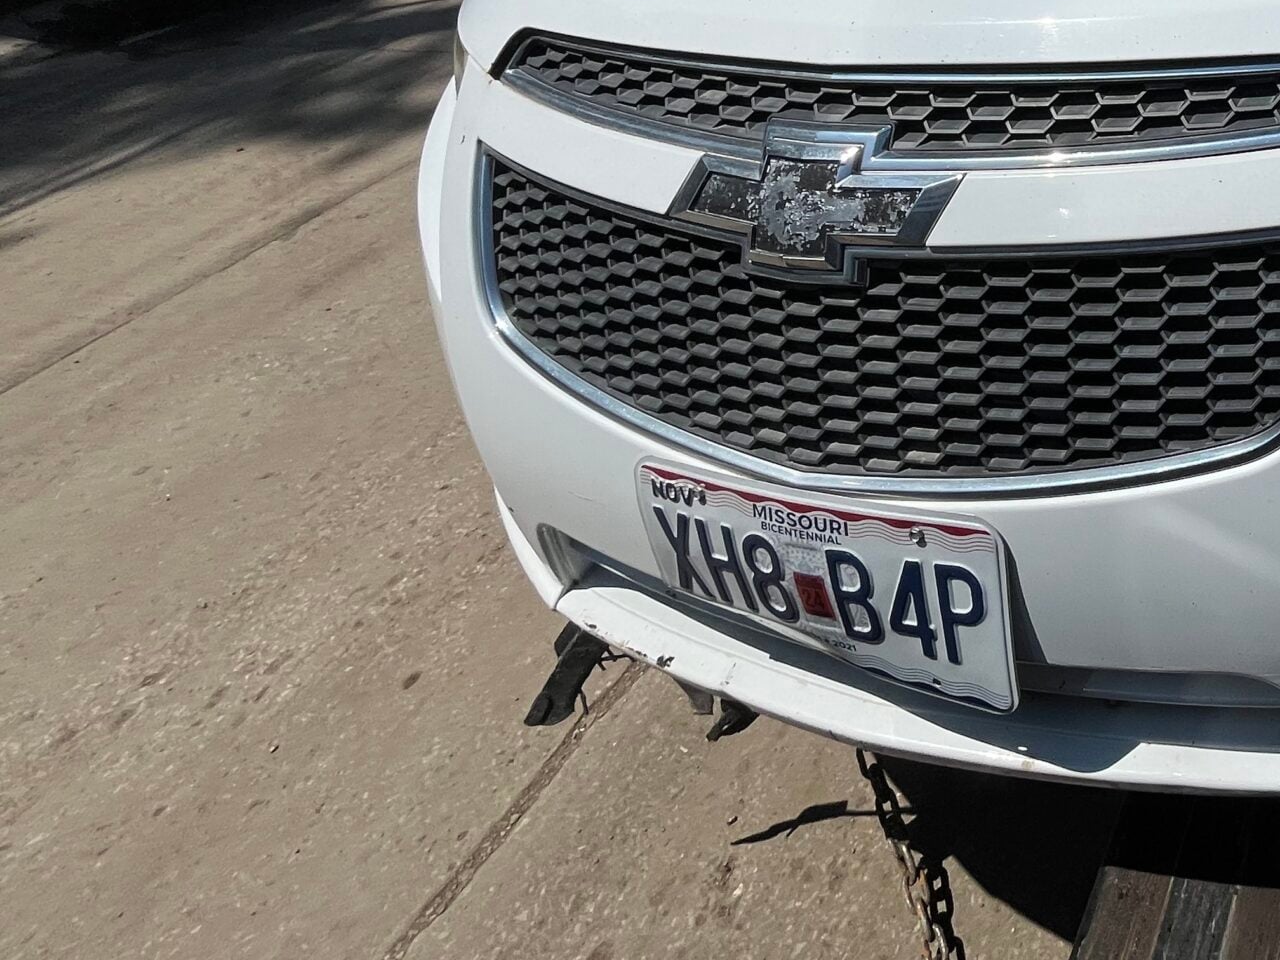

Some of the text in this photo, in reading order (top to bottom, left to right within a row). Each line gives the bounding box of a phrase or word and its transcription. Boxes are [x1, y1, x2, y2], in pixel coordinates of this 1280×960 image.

[651, 478, 694, 507] NOV
[752, 503, 849, 537] MISSOURI
[761, 521, 842, 545] BICENTENNIAL
[652, 505, 987, 665] XH8 B4P
[832, 640, 857, 652] 2021
